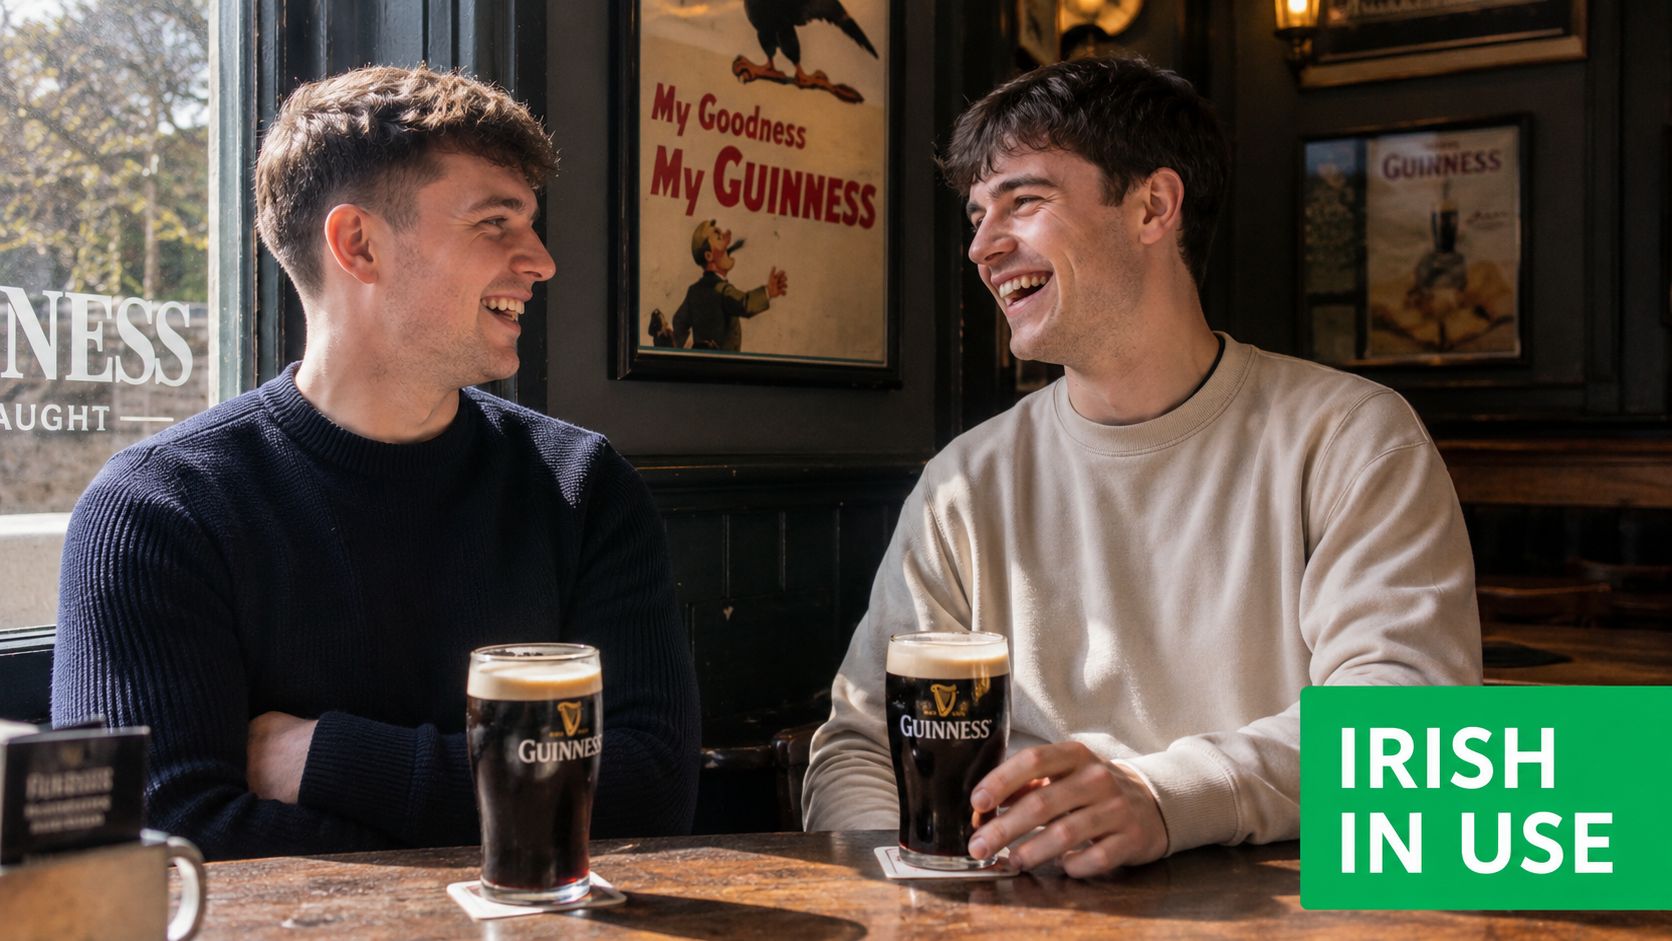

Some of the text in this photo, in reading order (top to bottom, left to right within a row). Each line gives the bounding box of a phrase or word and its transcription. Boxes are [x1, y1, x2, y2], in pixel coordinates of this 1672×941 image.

[651, 82, 806, 149] My Goodness
[650, 144, 876, 229] My GUINNESS
[1382, 150, 1502, 181] GUINNESS
[0, 285, 194, 387] NESS
[900, 714, 991, 739] GUINNESS
